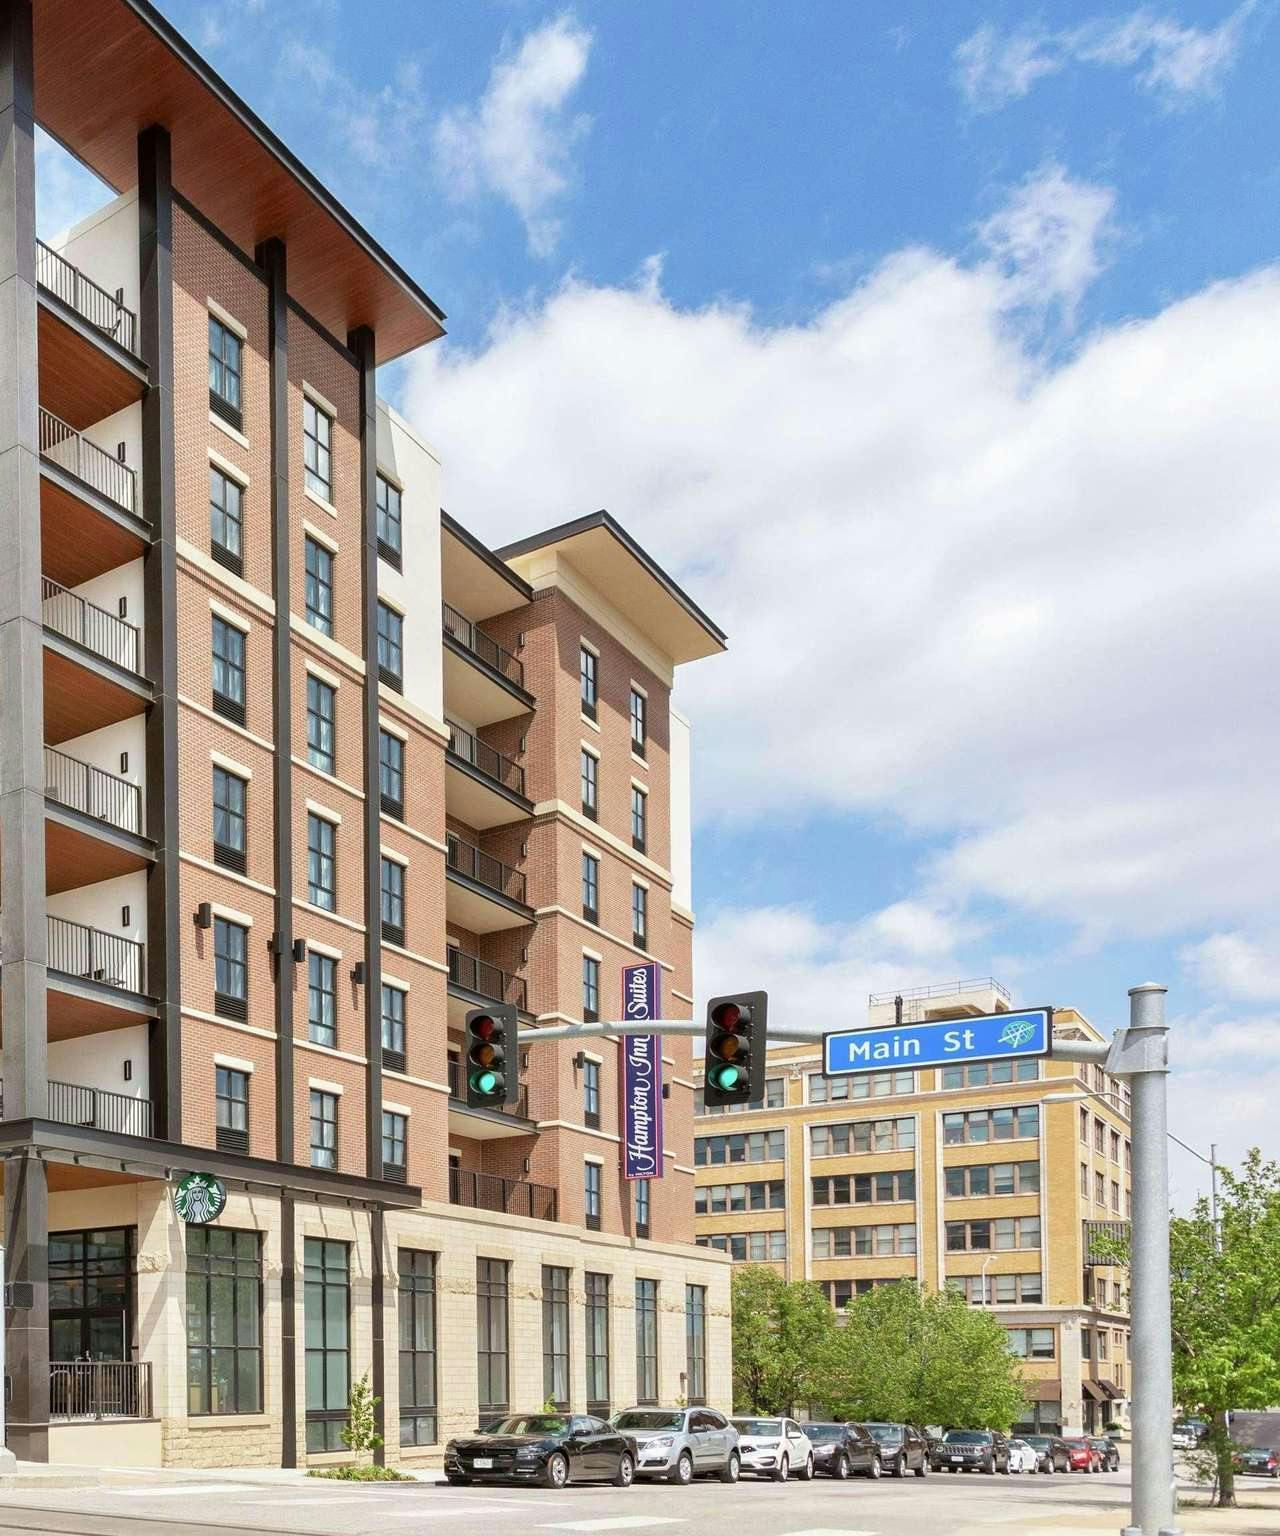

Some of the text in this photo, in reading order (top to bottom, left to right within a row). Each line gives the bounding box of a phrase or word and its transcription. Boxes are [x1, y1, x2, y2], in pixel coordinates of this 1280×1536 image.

[627, 968, 655, 1171] Hampton Inn Suites
[848, 1029, 975, 1062] Main St
